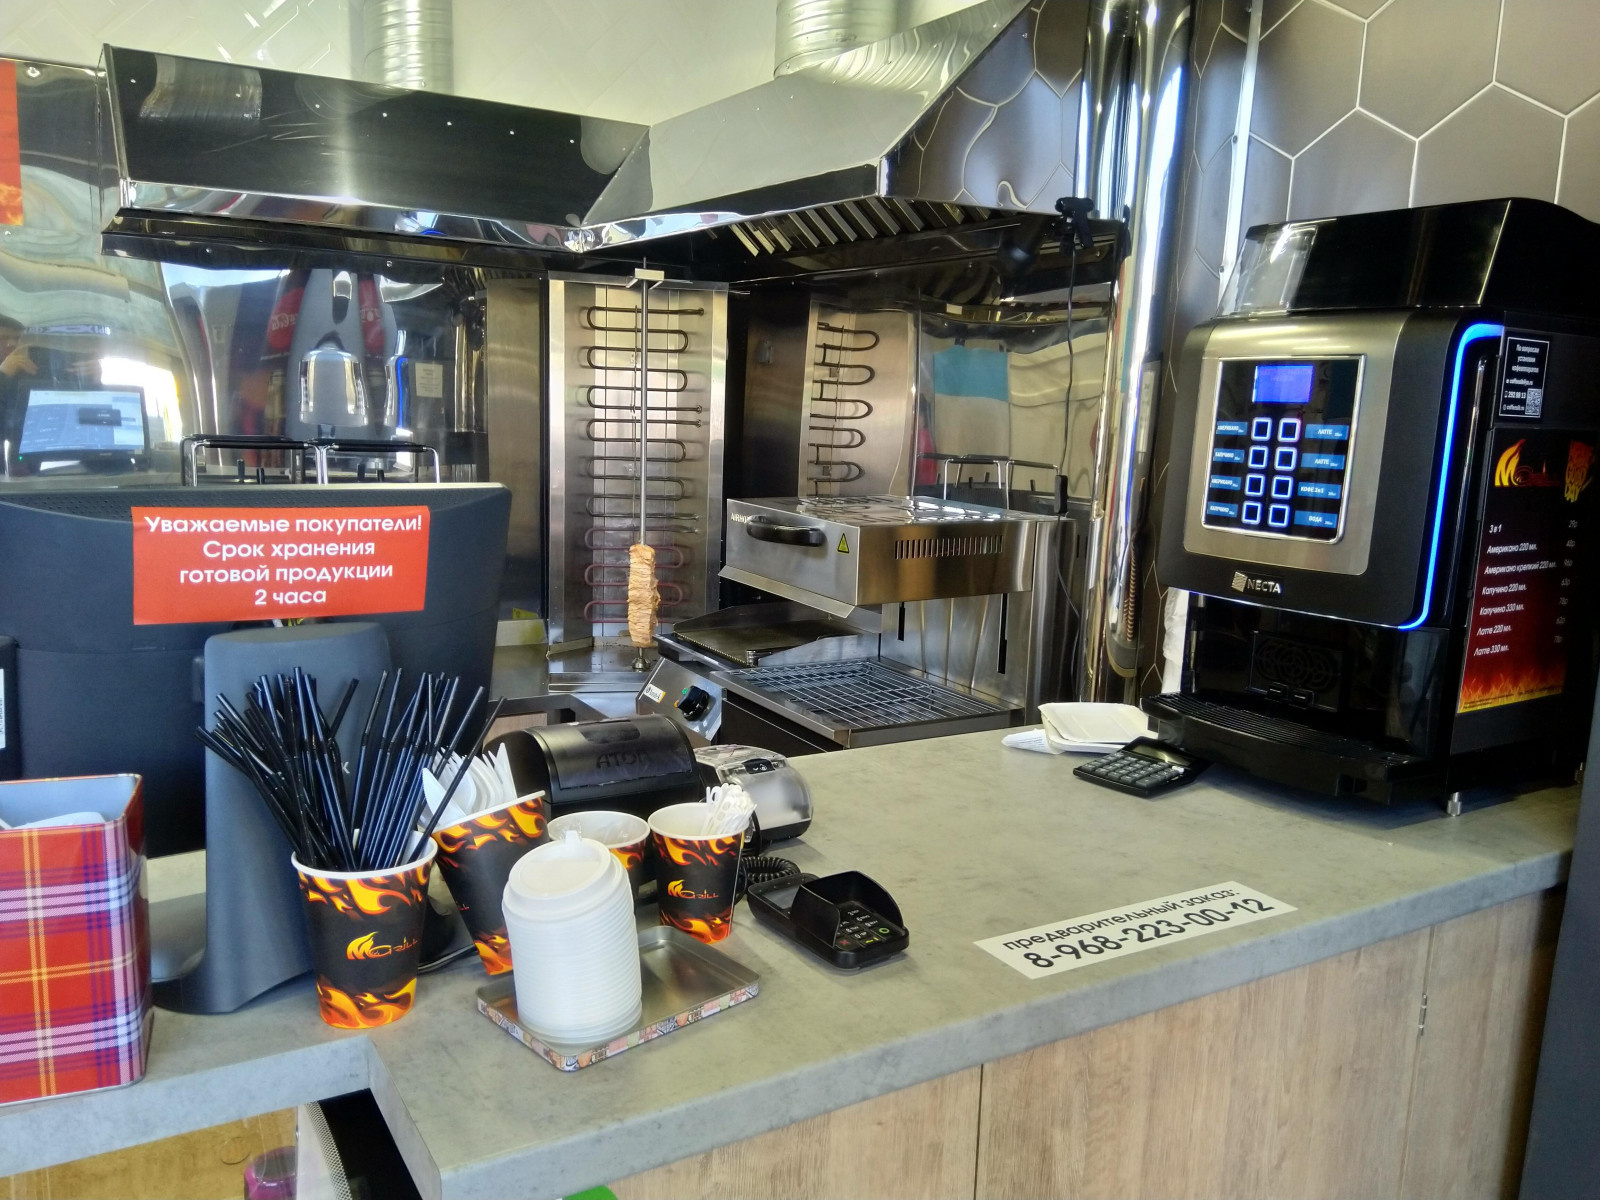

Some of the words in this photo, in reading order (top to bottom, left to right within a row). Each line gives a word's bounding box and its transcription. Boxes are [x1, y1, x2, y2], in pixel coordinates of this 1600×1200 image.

[144, 516, 290, 533] Уважаемые
[295, 514, 422, 536] покупатели!
[1489, 524, 1494, 533] 3
[203, 540, 265, 560] Срок
[271, 541, 375, 559] хранения
[1486, 545, 1519, 554] Американо
[1519, 542, 1529, 551] 220
[180, 565, 270, 584] готовой
[276, 565, 393, 584] продукции
[1484, 566, 1516, 575] Американо
[1247, 579, 1281, 594] NECTA
[1482, 586, 1508, 596] Капучино
[1508, 583, 1518, 592] 220
[255, 589, 267, 605] 2
[272, 589, 326, 605] часа
[1480, 606, 1505, 616] Капучино
[1506, 603, 1516, 612] 330
[1476, 627, 1493, 636] Латте
[1493, 624, 1503, 634] 220
[1473, 647, 1490, 656] Латте
[1490, 644, 1500, 653] 330
[1002, 900, 1183, 951] предварительный
[1184, 887, 1240, 907] заказ:
[1022, 898, 1275, 969] 8-968-223-00-12
